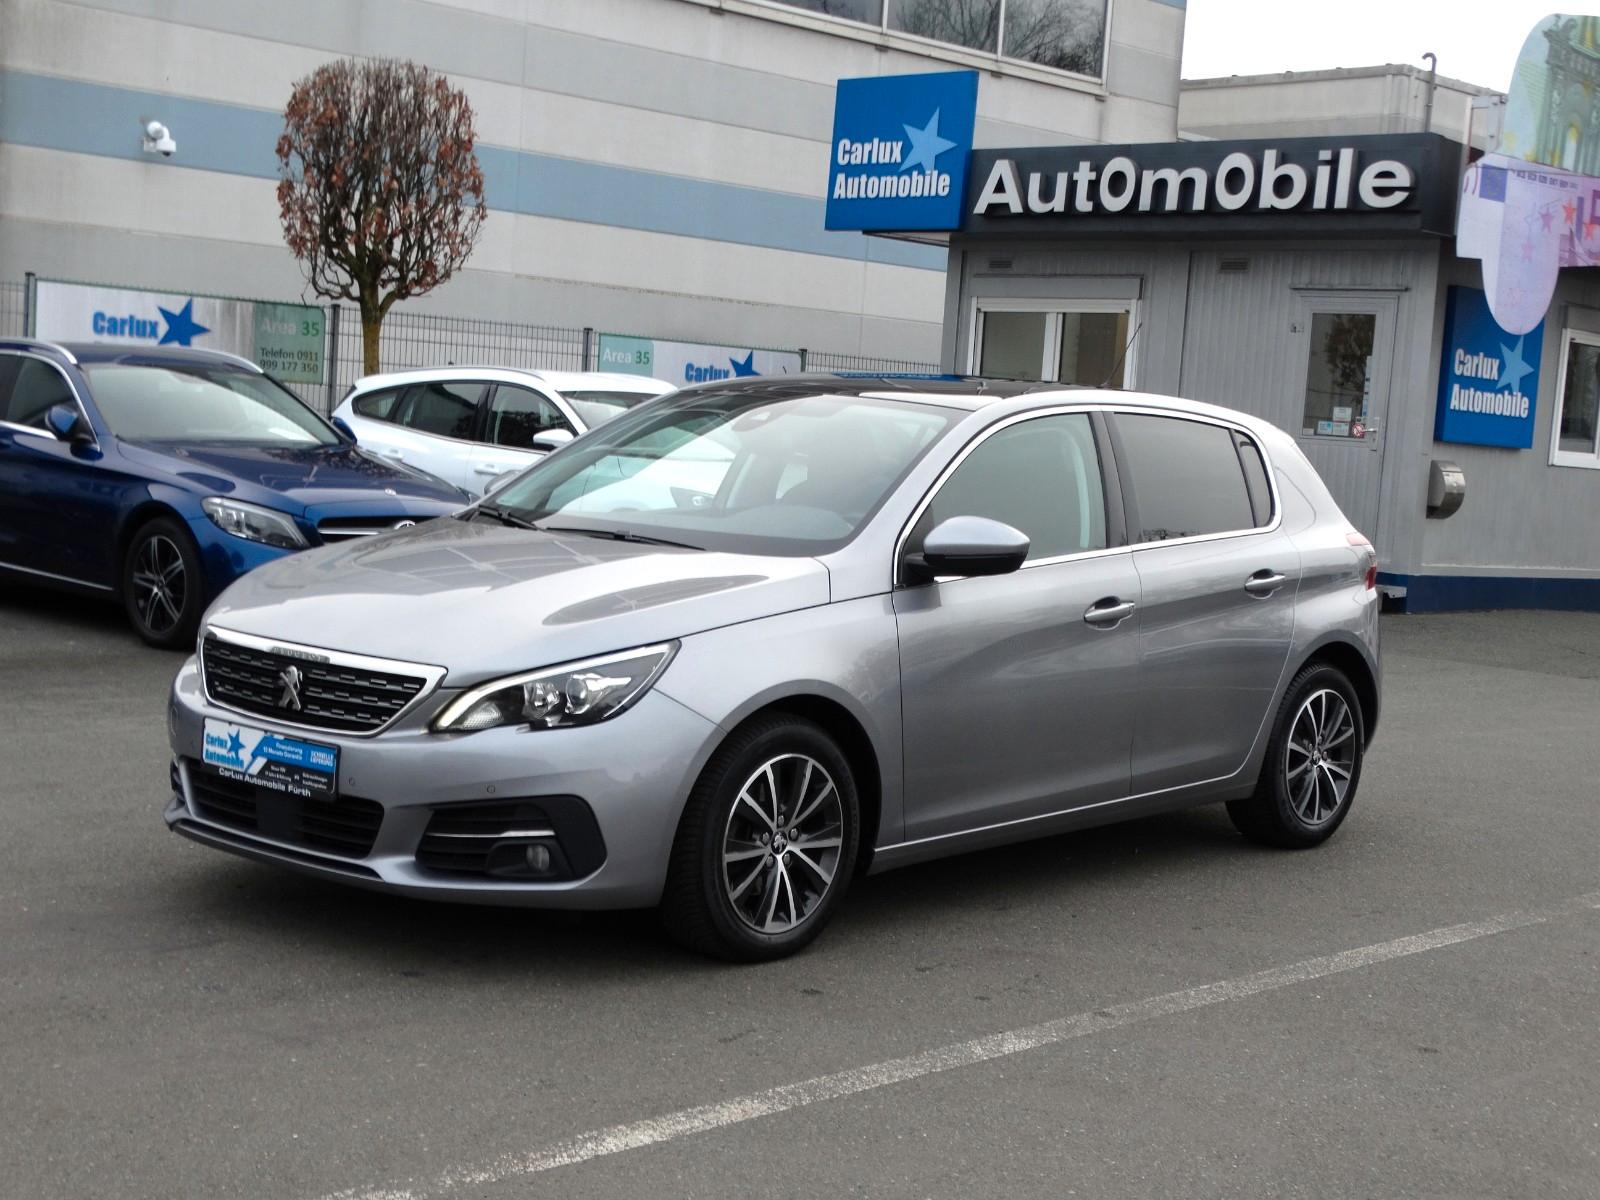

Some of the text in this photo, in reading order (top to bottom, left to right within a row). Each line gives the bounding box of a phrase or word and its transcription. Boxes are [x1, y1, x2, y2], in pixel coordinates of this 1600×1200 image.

[837, 138, 902, 166] Carlux
[833, 168, 950, 200] Automobile
[92, 310, 158, 339] Carlux
[262, 317, 320, 337] Area 35
[260, 347, 319, 361] Telefon 0911
[602, 347, 650, 365] Area 35
[1454, 348, 1499, 380] Carlux
[260, 360, 319, 374] 999 177 350
[685, 362, 730, 382] Carlux
[1450, 383, 1529, 418] Automobile
[244, 773, 286, 792] Automobile
[288, 784, 312, 798] Fürth
